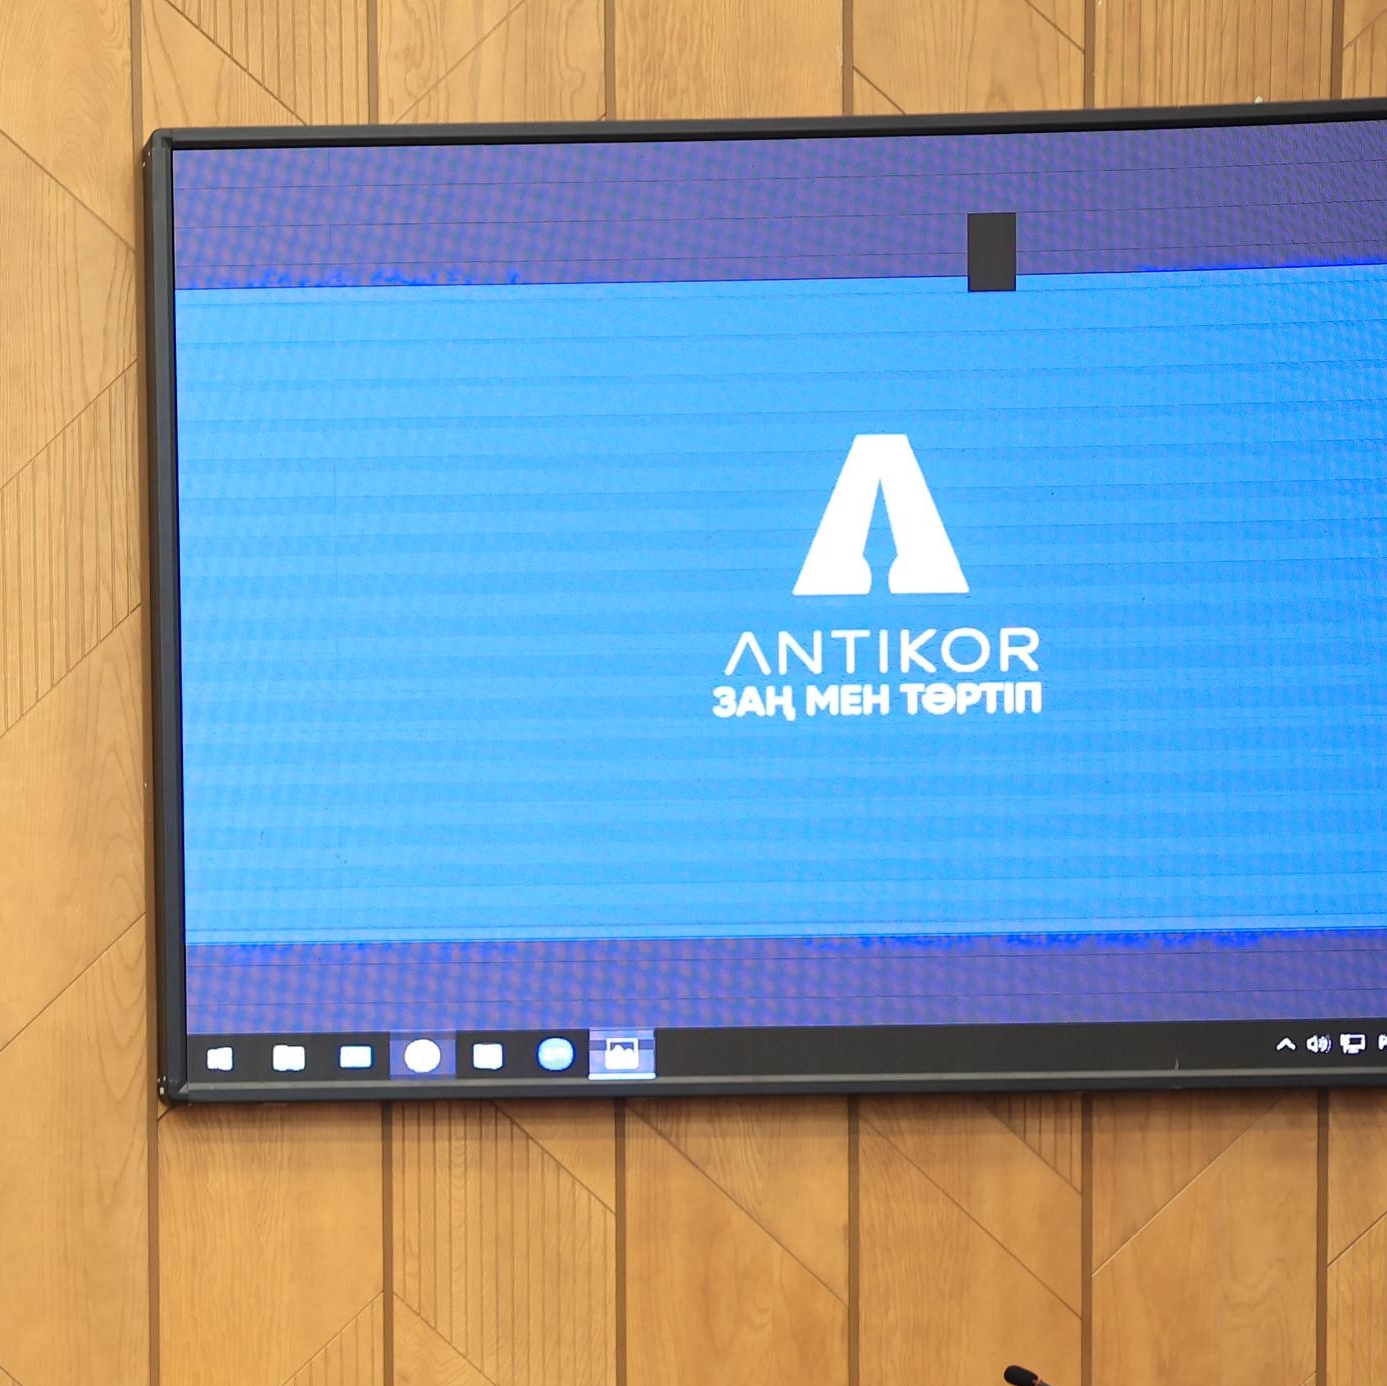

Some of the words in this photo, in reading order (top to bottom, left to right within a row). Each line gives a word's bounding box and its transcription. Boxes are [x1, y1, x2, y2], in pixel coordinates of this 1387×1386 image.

[724, 627, 1039, 675] ANTIKOR
[712, 685, 795, 721] ЗАҢ
[806, 683, 889, 716] МЕН
